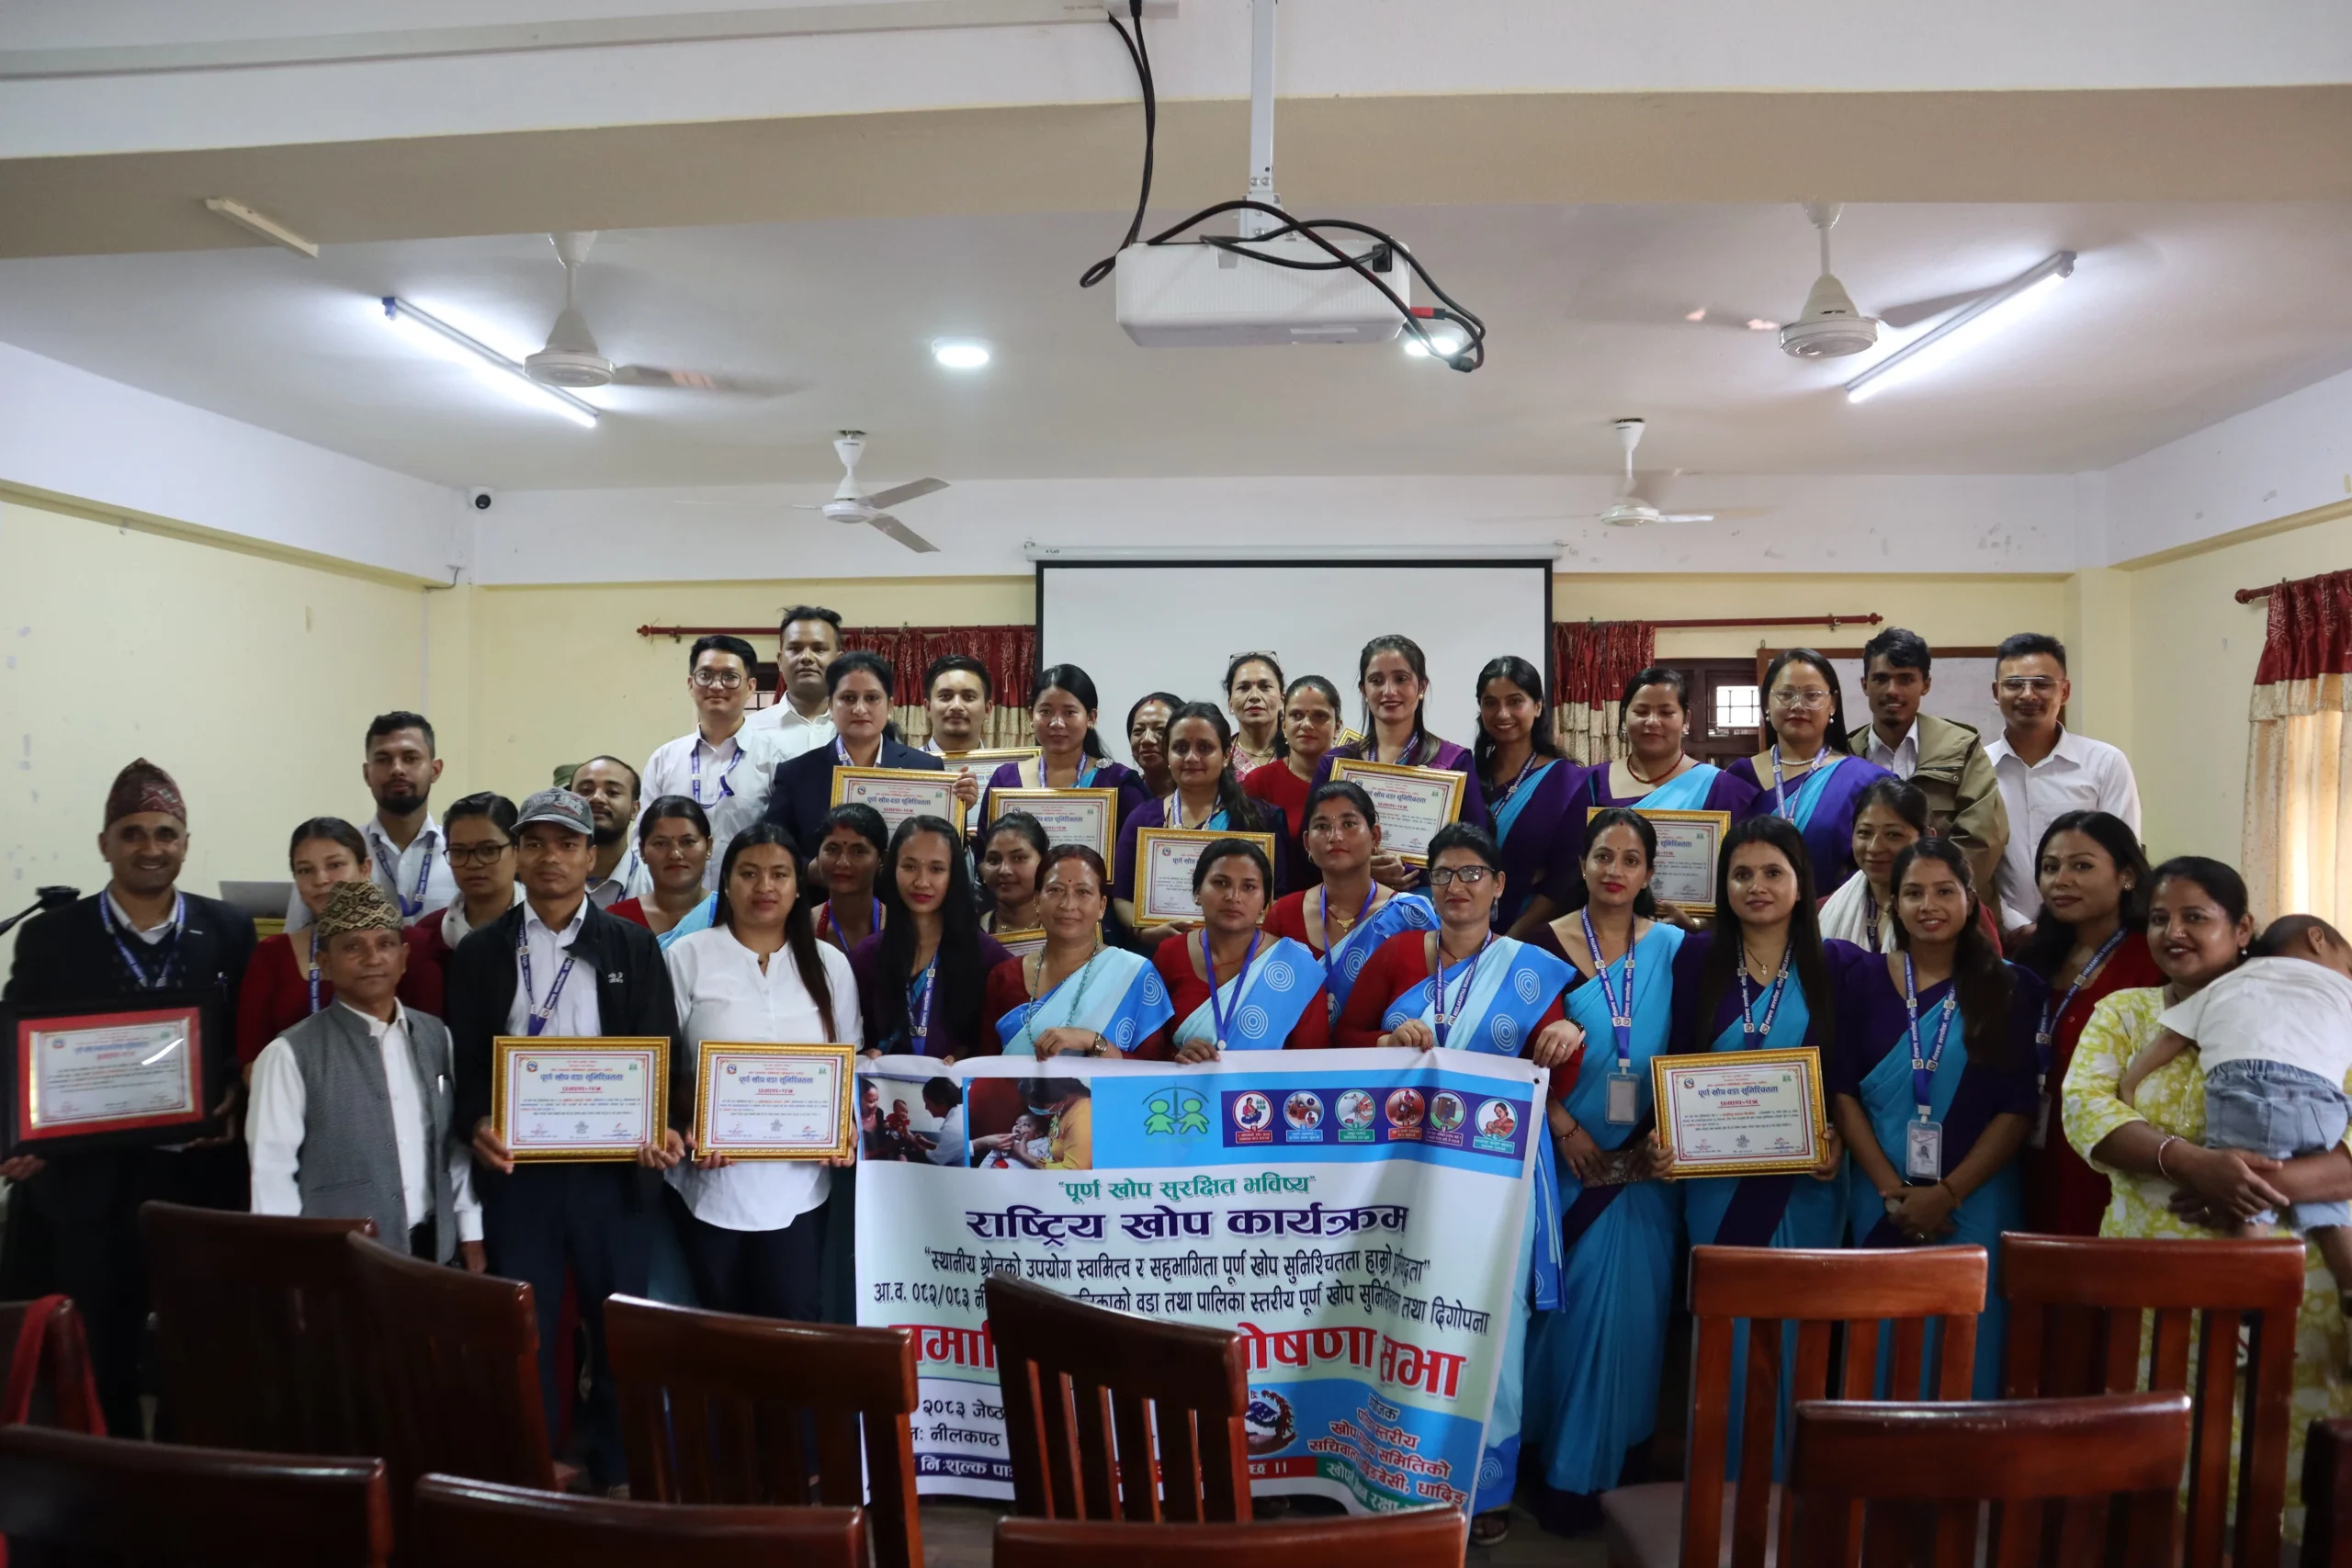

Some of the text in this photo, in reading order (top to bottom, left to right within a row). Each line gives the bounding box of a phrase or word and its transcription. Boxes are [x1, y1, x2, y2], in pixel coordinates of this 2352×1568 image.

[1108, 1178, 1152, 1199] खोप
[1159, 1175, 1236, 1201] सुरक्षित
[966, 1201, 1408, 1247] राष्ट्रिय खोप कार्यक्रम
[1026, 1252, 1071, 1279] उपयोग
[1077, 1252, 1130, 1279] स्वामित्व
[1135, 1258, 1145, 1277] र
[1150, 1249, 1218, 1282] सहभागिता
[1223, 1248, 1246, 1284] पूर्ण
[1250, 1248, 1279, 1277] खोप
[1283, 1248, 1360, 1285] सुनिश्चितता
[1365, 1243, 1393, 1275] हाम्रो
[874, 1282, 907, 1302] आ.व.
[912, 1282, 970, 1313] ०८२/०८३
[1136, 1292, 1160, 1313] वडा
[1165, 1292, 1193, 1313] तथा
[1197, 1284, 1245, 1314] पालिका
[1250, 1284, 1295, 1313] स्तरीय
[1299, 1281, 1322, 1315] पूर्ण
[1326, 1280, 1354, 1306] खोप
[1401, 1296, 1428, 1322] तथा
[1430, 1295, 1490, 1334] दिगोपना
[1238, 1322, 1467, 1399] ोषणा सभा
[922, 1399, 965, 1419] २०८३
[930, 1423, 1001, 1447] नीलकण्ठ
[1329, 1417, 1358, 1439] खोप
[1378, 1448, 1452, 1480] समितिको
[1374, 1423, 1419, 1450] स्तरीय
[1417, 1479, 1468, 1506] धादिङ
